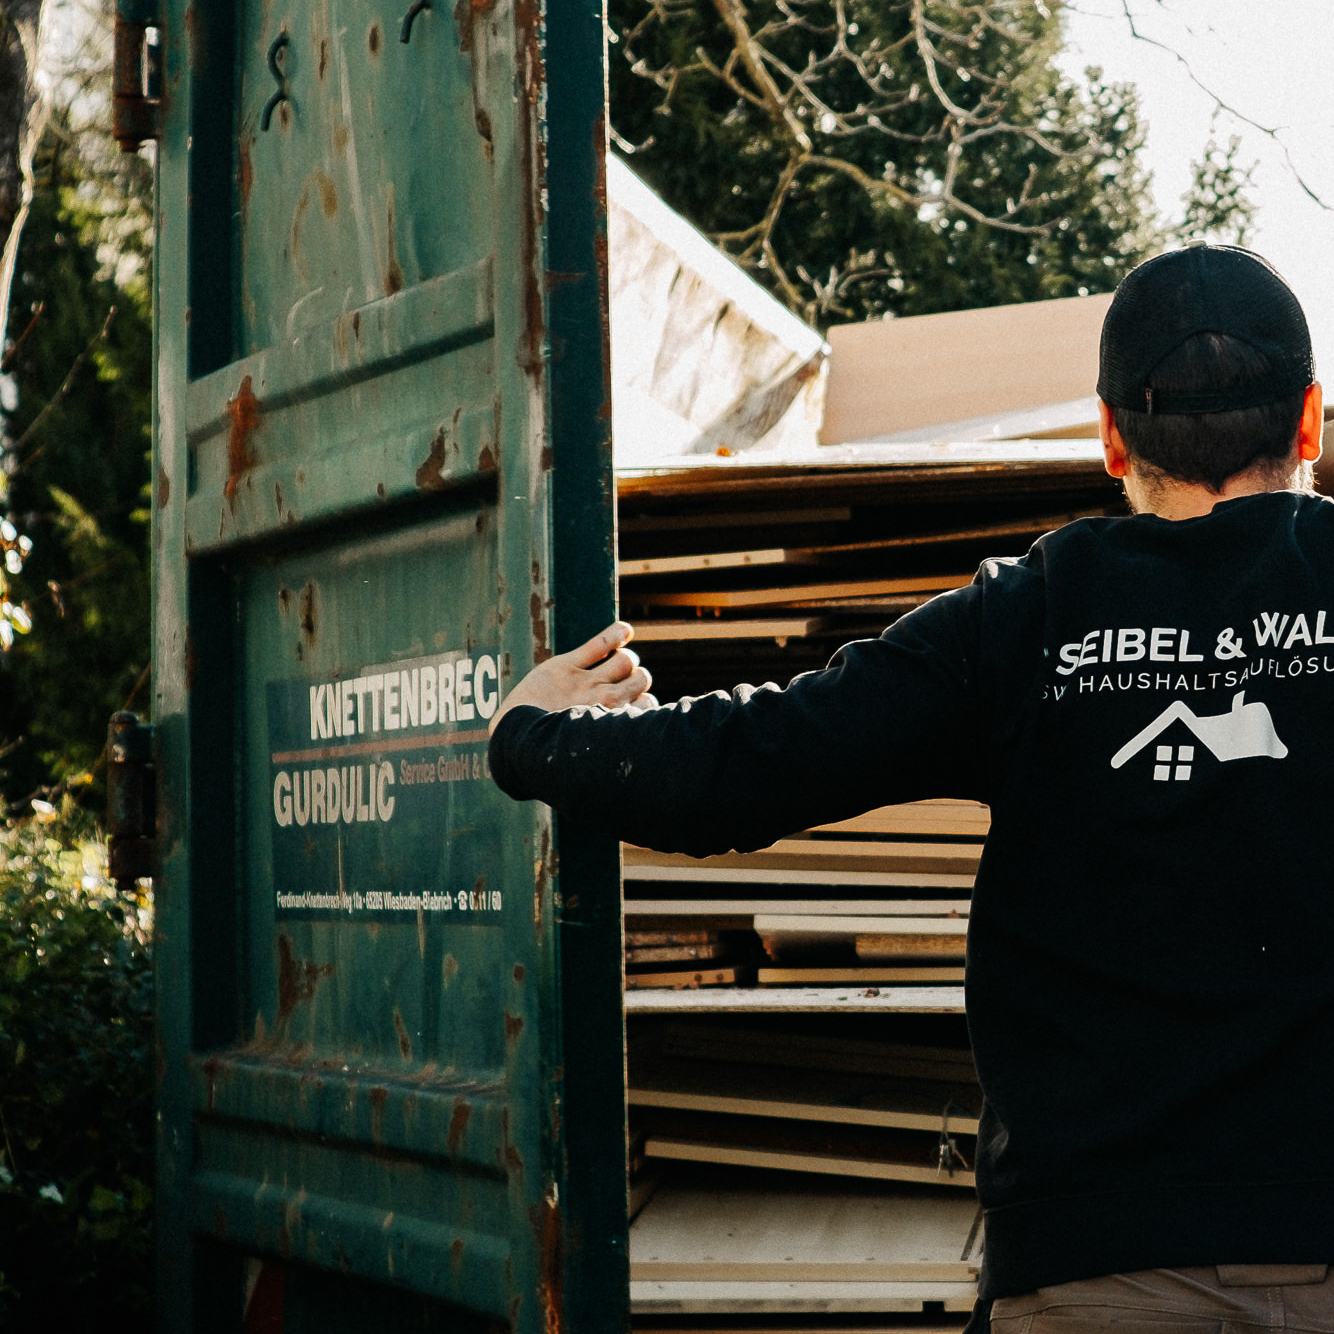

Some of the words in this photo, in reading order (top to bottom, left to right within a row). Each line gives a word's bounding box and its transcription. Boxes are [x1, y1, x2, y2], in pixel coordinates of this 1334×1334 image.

[1056, 627, 1204, 676] SEIBEL
[1214, 627, 1247, 660] &
[273, 760, 395, 827] GURDULIC
[400, 758, 436, 786] Service
[472, 752, 481, 780] &
